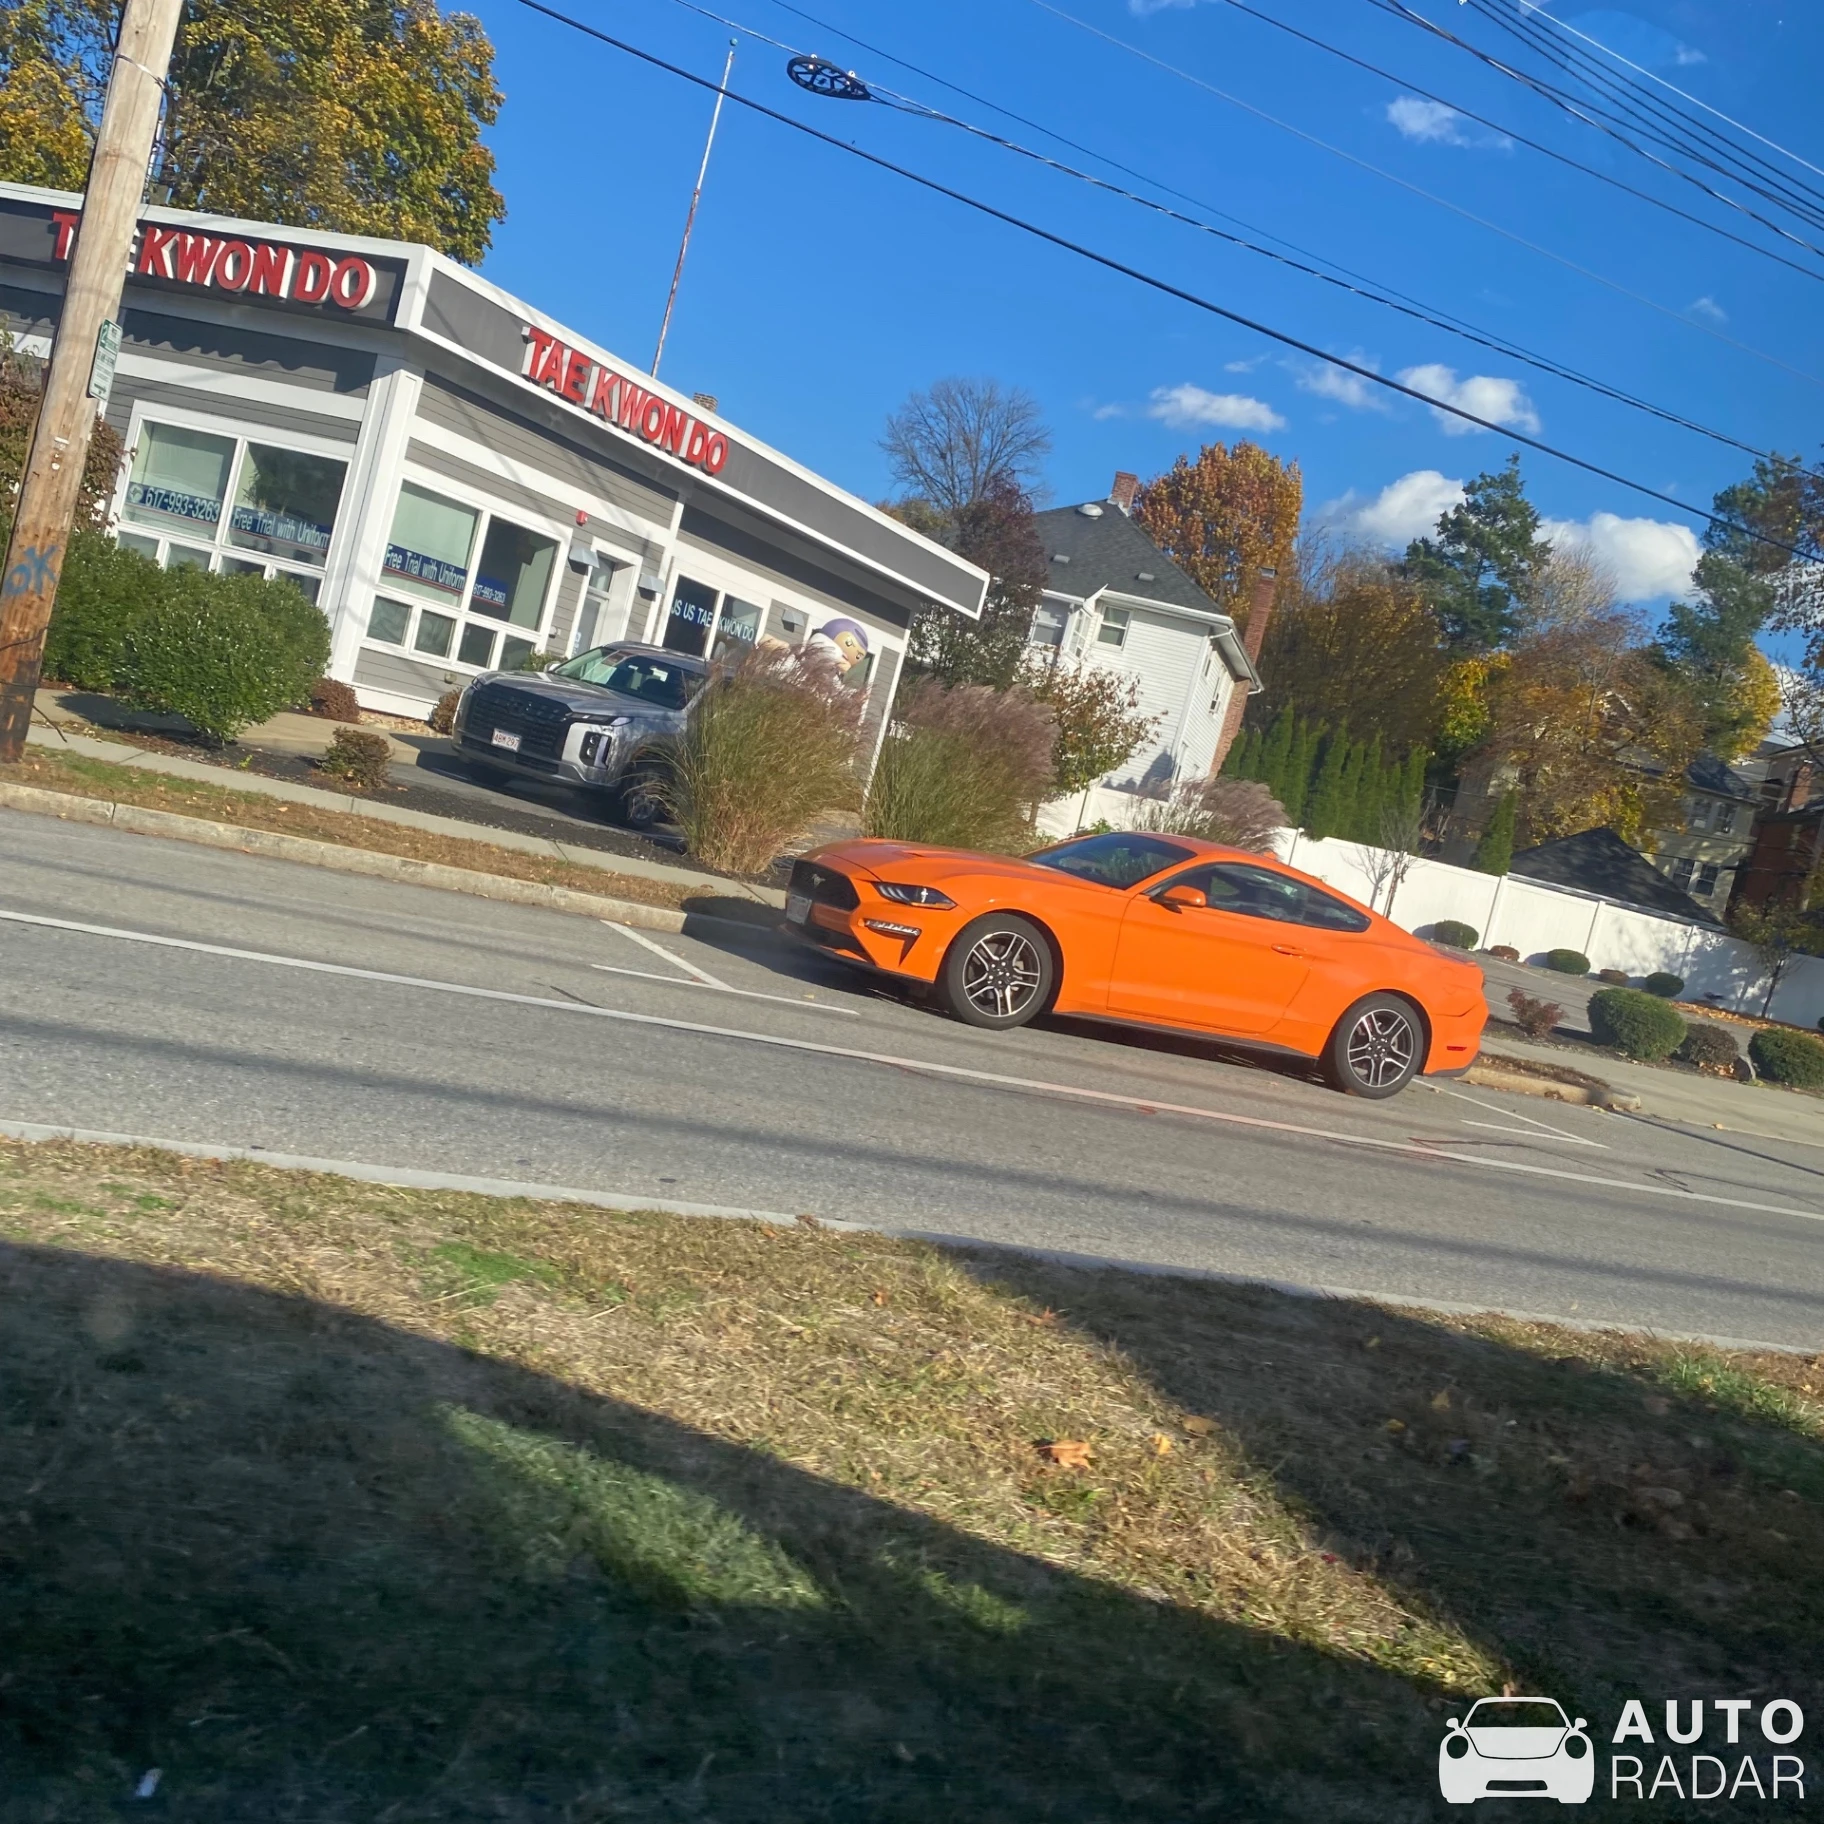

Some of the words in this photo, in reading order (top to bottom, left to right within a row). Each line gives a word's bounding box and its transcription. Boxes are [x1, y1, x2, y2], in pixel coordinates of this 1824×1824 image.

[139, 226, 291, 298] KWON
[293, 251, 376, 311] DO
[522, 326, 591, 402] TAE
[586, 366, 688, 454] KWON
[685, 419, 729, 475] DO
[145, 487, 220, 523] 617-993-3263
[232, 507, 253, 530] Free
[255, 512, 276, 536] Trial
[276, 518, 296, 540] with
[297, 521, 331, 548] Uniform
[384, 545, 403, 570] Free
[403, 551, 422, 576] Trial
[421, 560, 438, 581] with
[438, 564, 466, 591] Uniform
[683, 602, 696, 621] US
[697, 607, 714, 627] TAE
[717, 616, 741, 638] KWON
[742, 626, 755, 641] DO
